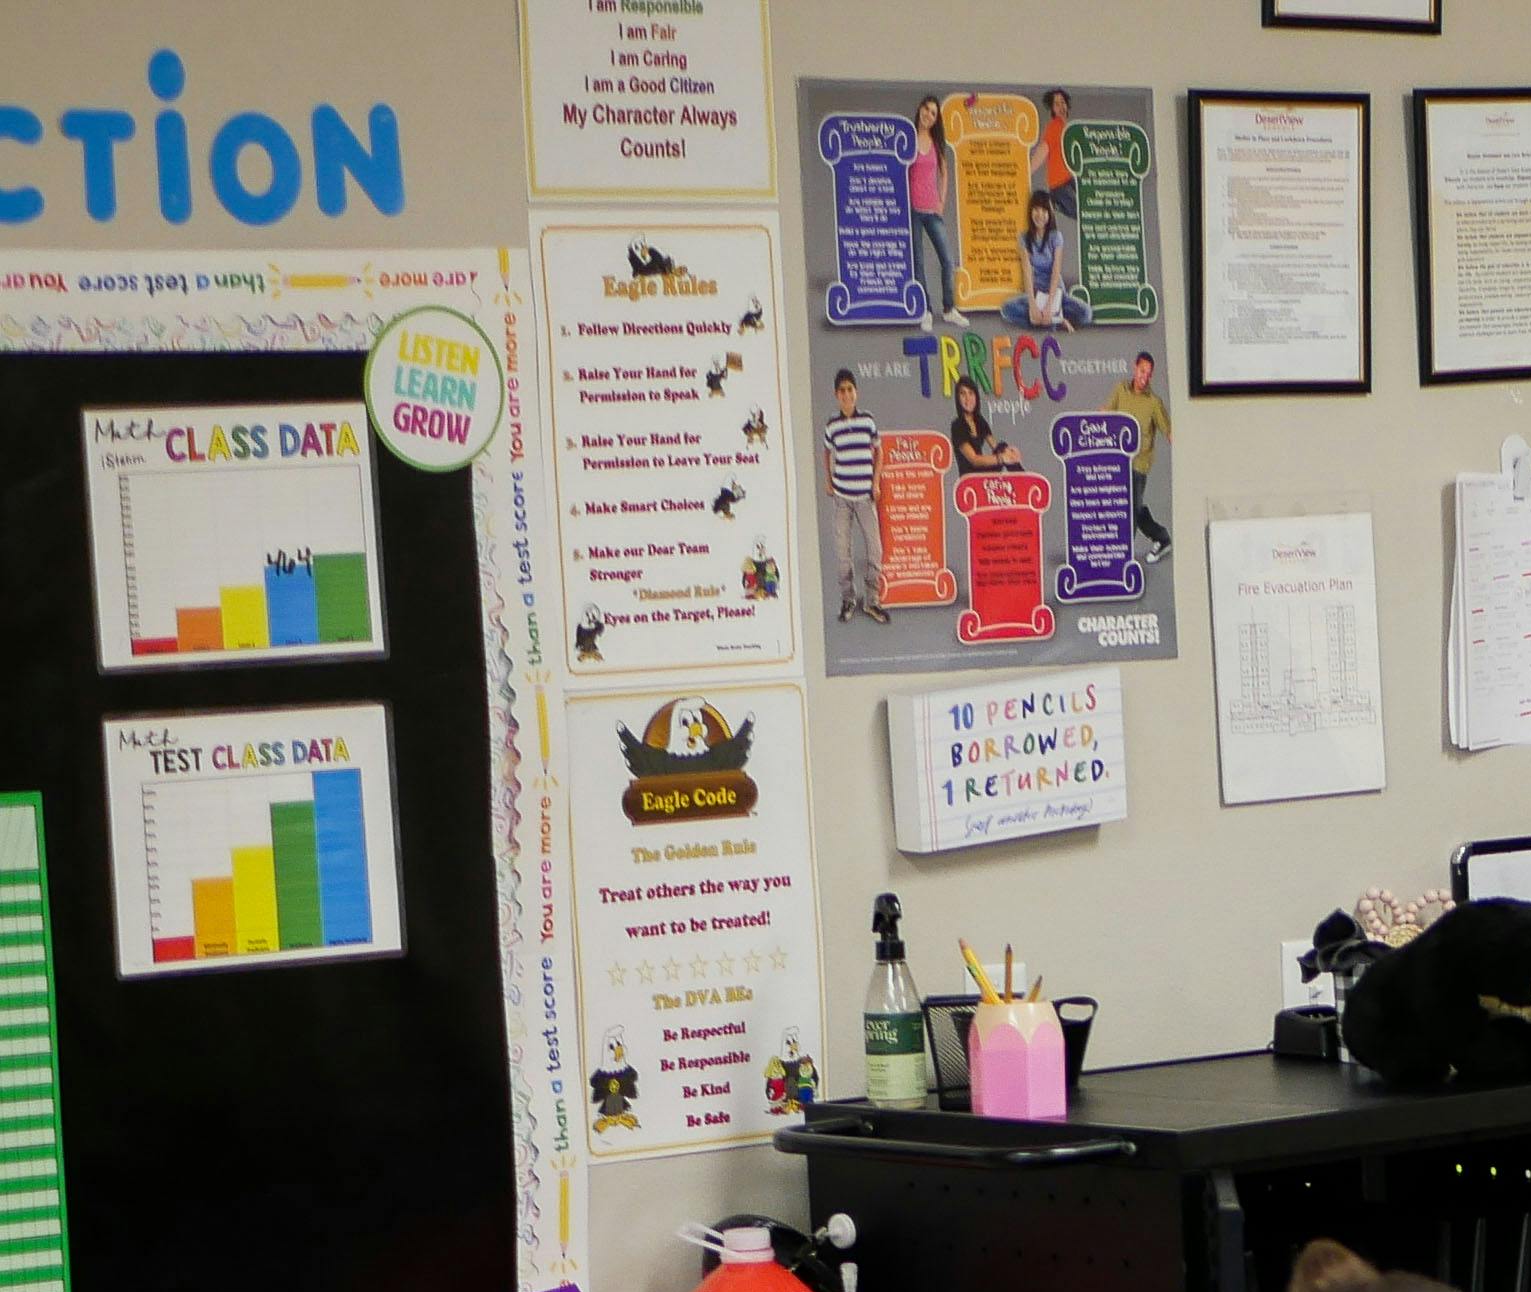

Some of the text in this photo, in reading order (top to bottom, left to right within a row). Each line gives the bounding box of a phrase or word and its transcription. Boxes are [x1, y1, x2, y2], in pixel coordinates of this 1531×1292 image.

[627, 27, 647, 40] am
[651, 23, 677, 41] Fair
[618, 53, 639, 66] am
[643, 50, 687, 70] Caring
[593, 79, 613, 92] am
[617, 79, 625, 92] a
[629, 76, 666, 93] Good
[669, 76, 715, 94] Citizen
[563, 103, 737, 130] My Character Always
[620, 137, 686, 159] Counts!
[602, 275, 657, 302] Eagle
[577, 321, 732, 337] Follow Directions Quickly
[398, 329, 481, 376] LISTEN
[858, 361, 911, 378] WE ARE
[903, 333, 1067, 402] TRRFCC
[1060, 358, 1128, 376] TOGETHER
[394, 365, 477, 410] LEARN
[986, 388, 1032, 425] people
[393, 403, 472, 446] GROW
[165, 421, 361, 462] CLASS DATA
[585, 499, 705, 515] Make Smart Choices
[1237, 577, 1353, 597] Fire Evacuation Plan
[604, 605, 755, 628] Eyes on the Target, Please!
[1077, 614, 1159, 633] CHARACTER
[1098, 629, 1160, 647] COUNTS!
[948, 683, 1097, 731] 10 PENCILS
[150, 736, 352, 775] TEST CLASS DATA
[951, 723, 1098, 768] BORROWED,
[942, 759, 1109, 806] 1 RETURNED.
[642, 788, 737, 814] Eagle Code
[599, 875, 791, 904] Treat others the way you
[625, 911, 771, 938] want to be treated!
[663, 1021, 746, 1042] Be Respectful
[660, 1052, 751, 1072] Be Responsible
[682, 1082, 731, 1098] Be Kind
[685, 1112, 731, 1128] Be Safe
